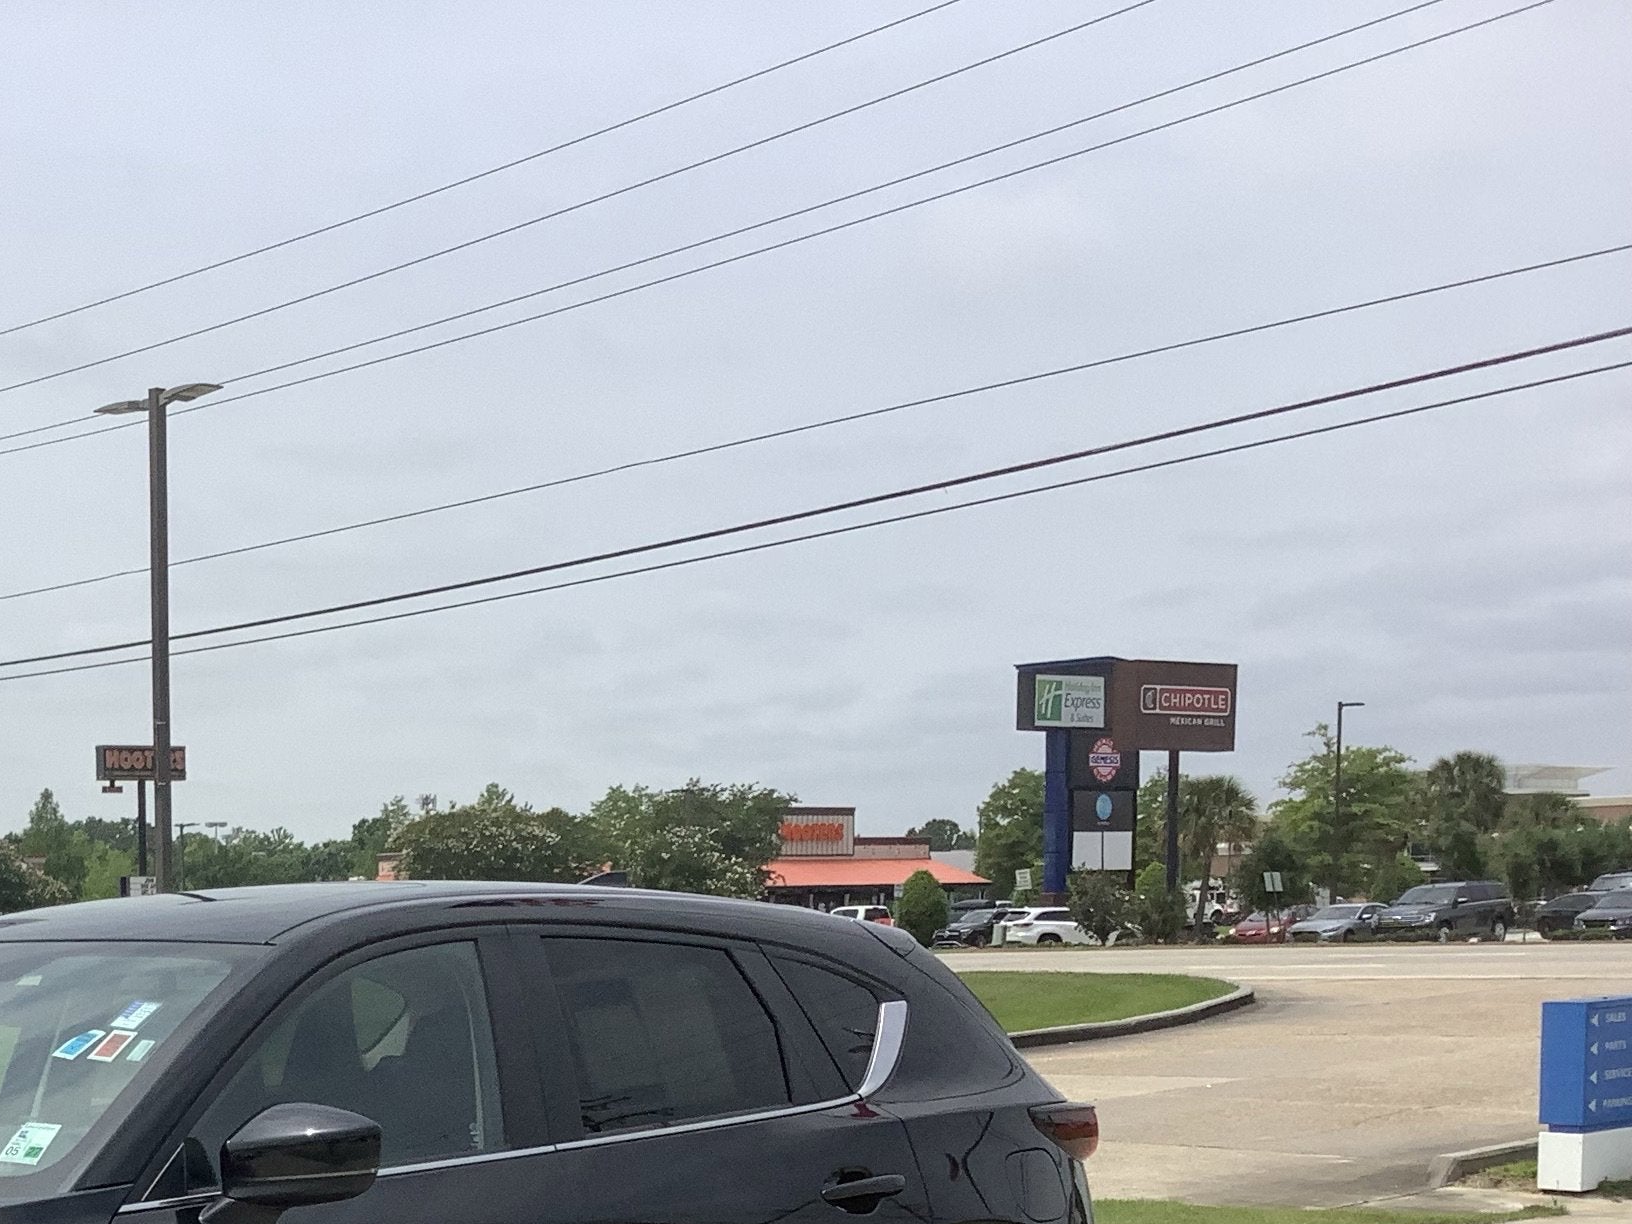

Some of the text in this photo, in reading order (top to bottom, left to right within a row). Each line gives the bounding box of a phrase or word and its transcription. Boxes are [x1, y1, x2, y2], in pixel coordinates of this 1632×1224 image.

[1064, 693, 1102, 711] Express
[1161, 692, 1226, 709] CHIPOTLE
[1169, 716, 1226, 727] MEXICAN GRILL
[105, 750, 185, 770] HOOTS
[1605, 1011, 1626, 1023] SALES
